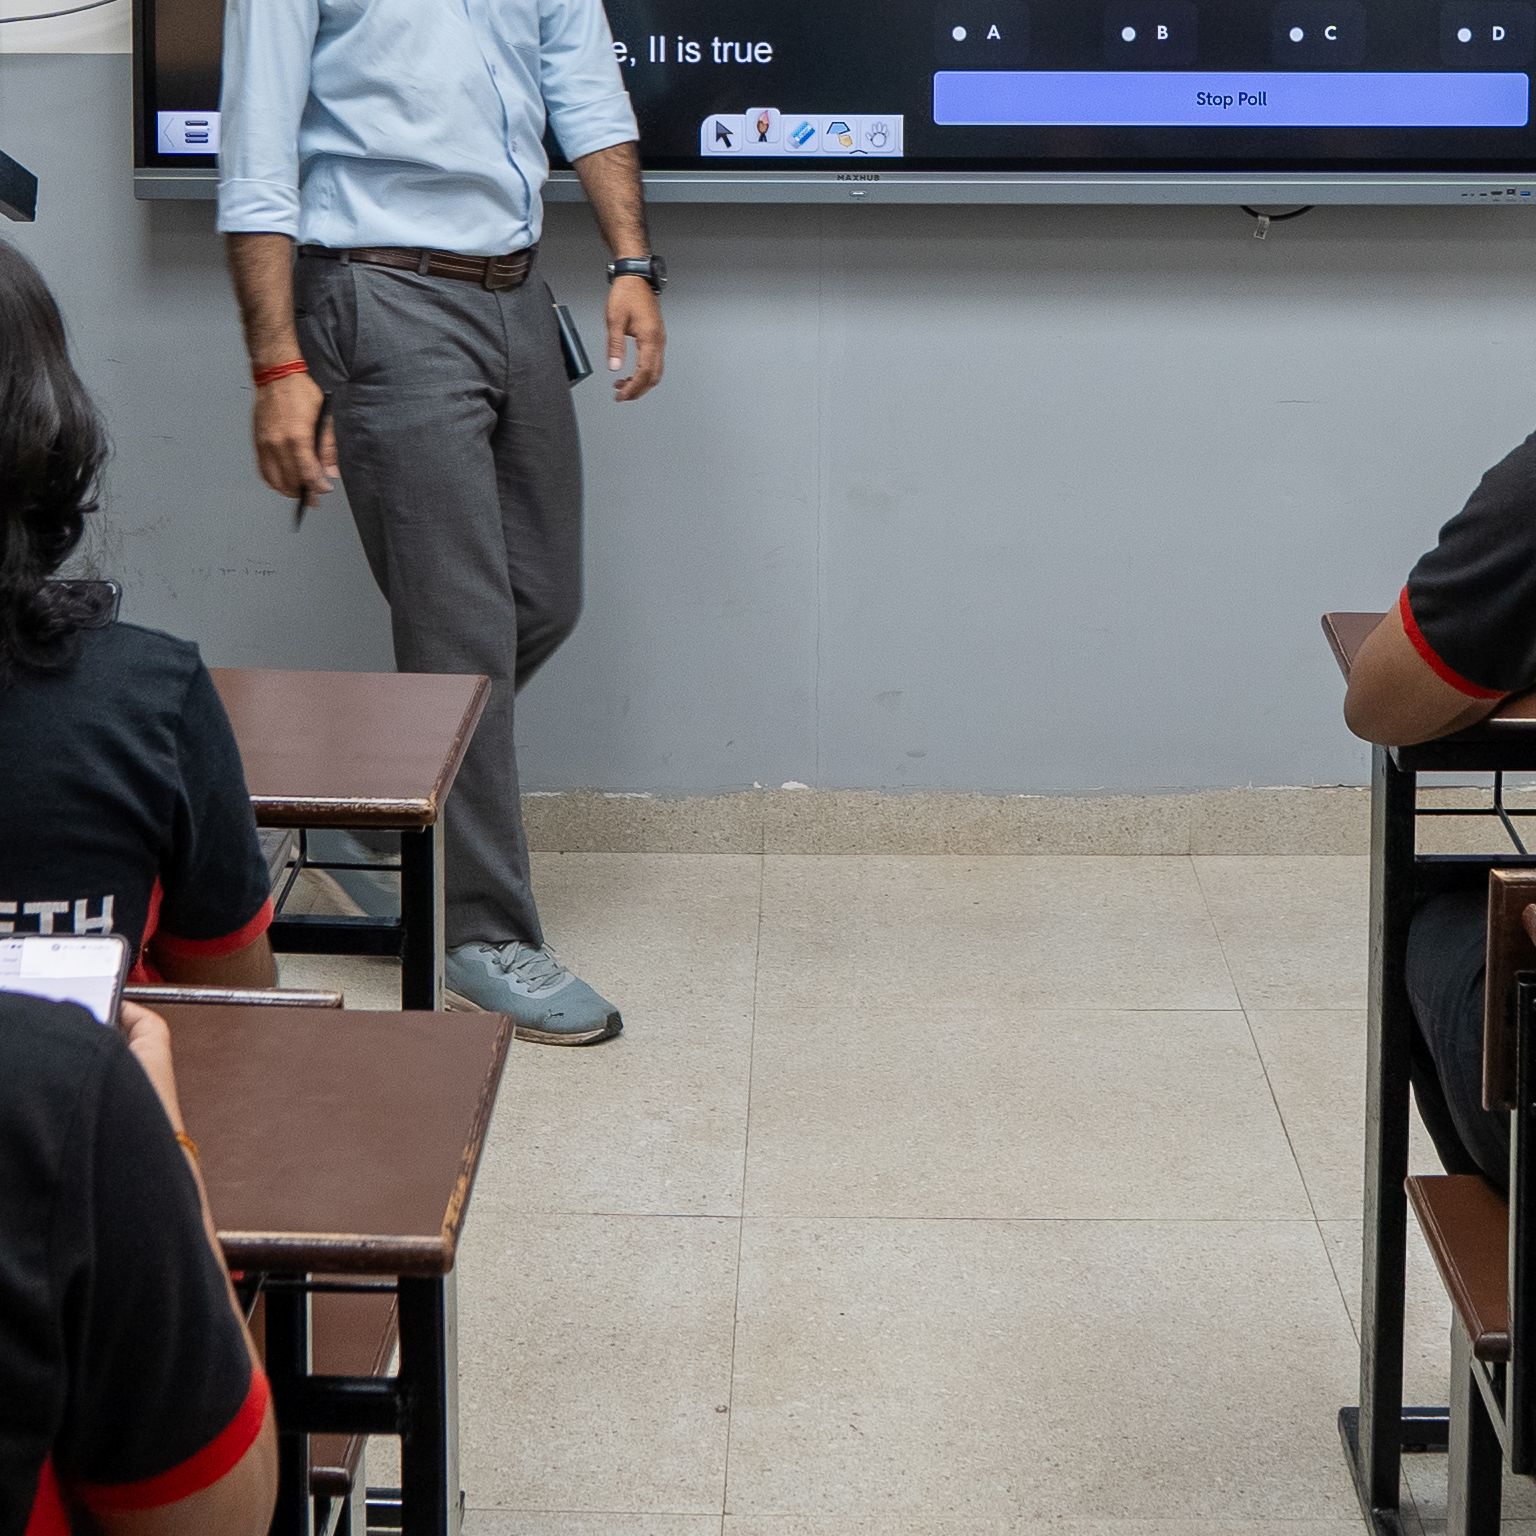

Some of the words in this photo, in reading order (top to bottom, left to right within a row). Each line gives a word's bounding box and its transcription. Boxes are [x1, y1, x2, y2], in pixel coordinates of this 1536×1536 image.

[987, 25, 1000, 39] A
[1158, 26, 1168, 39] B
[1325, 26, 1336, 40] C
[1493, 26, 1504, 40] D
[678, 36, 701, 62] is
[712, 37, 772, 62] true
[1197, 92, 1233, 109] Stop
[1239, 91, 1267, 106] Poll
